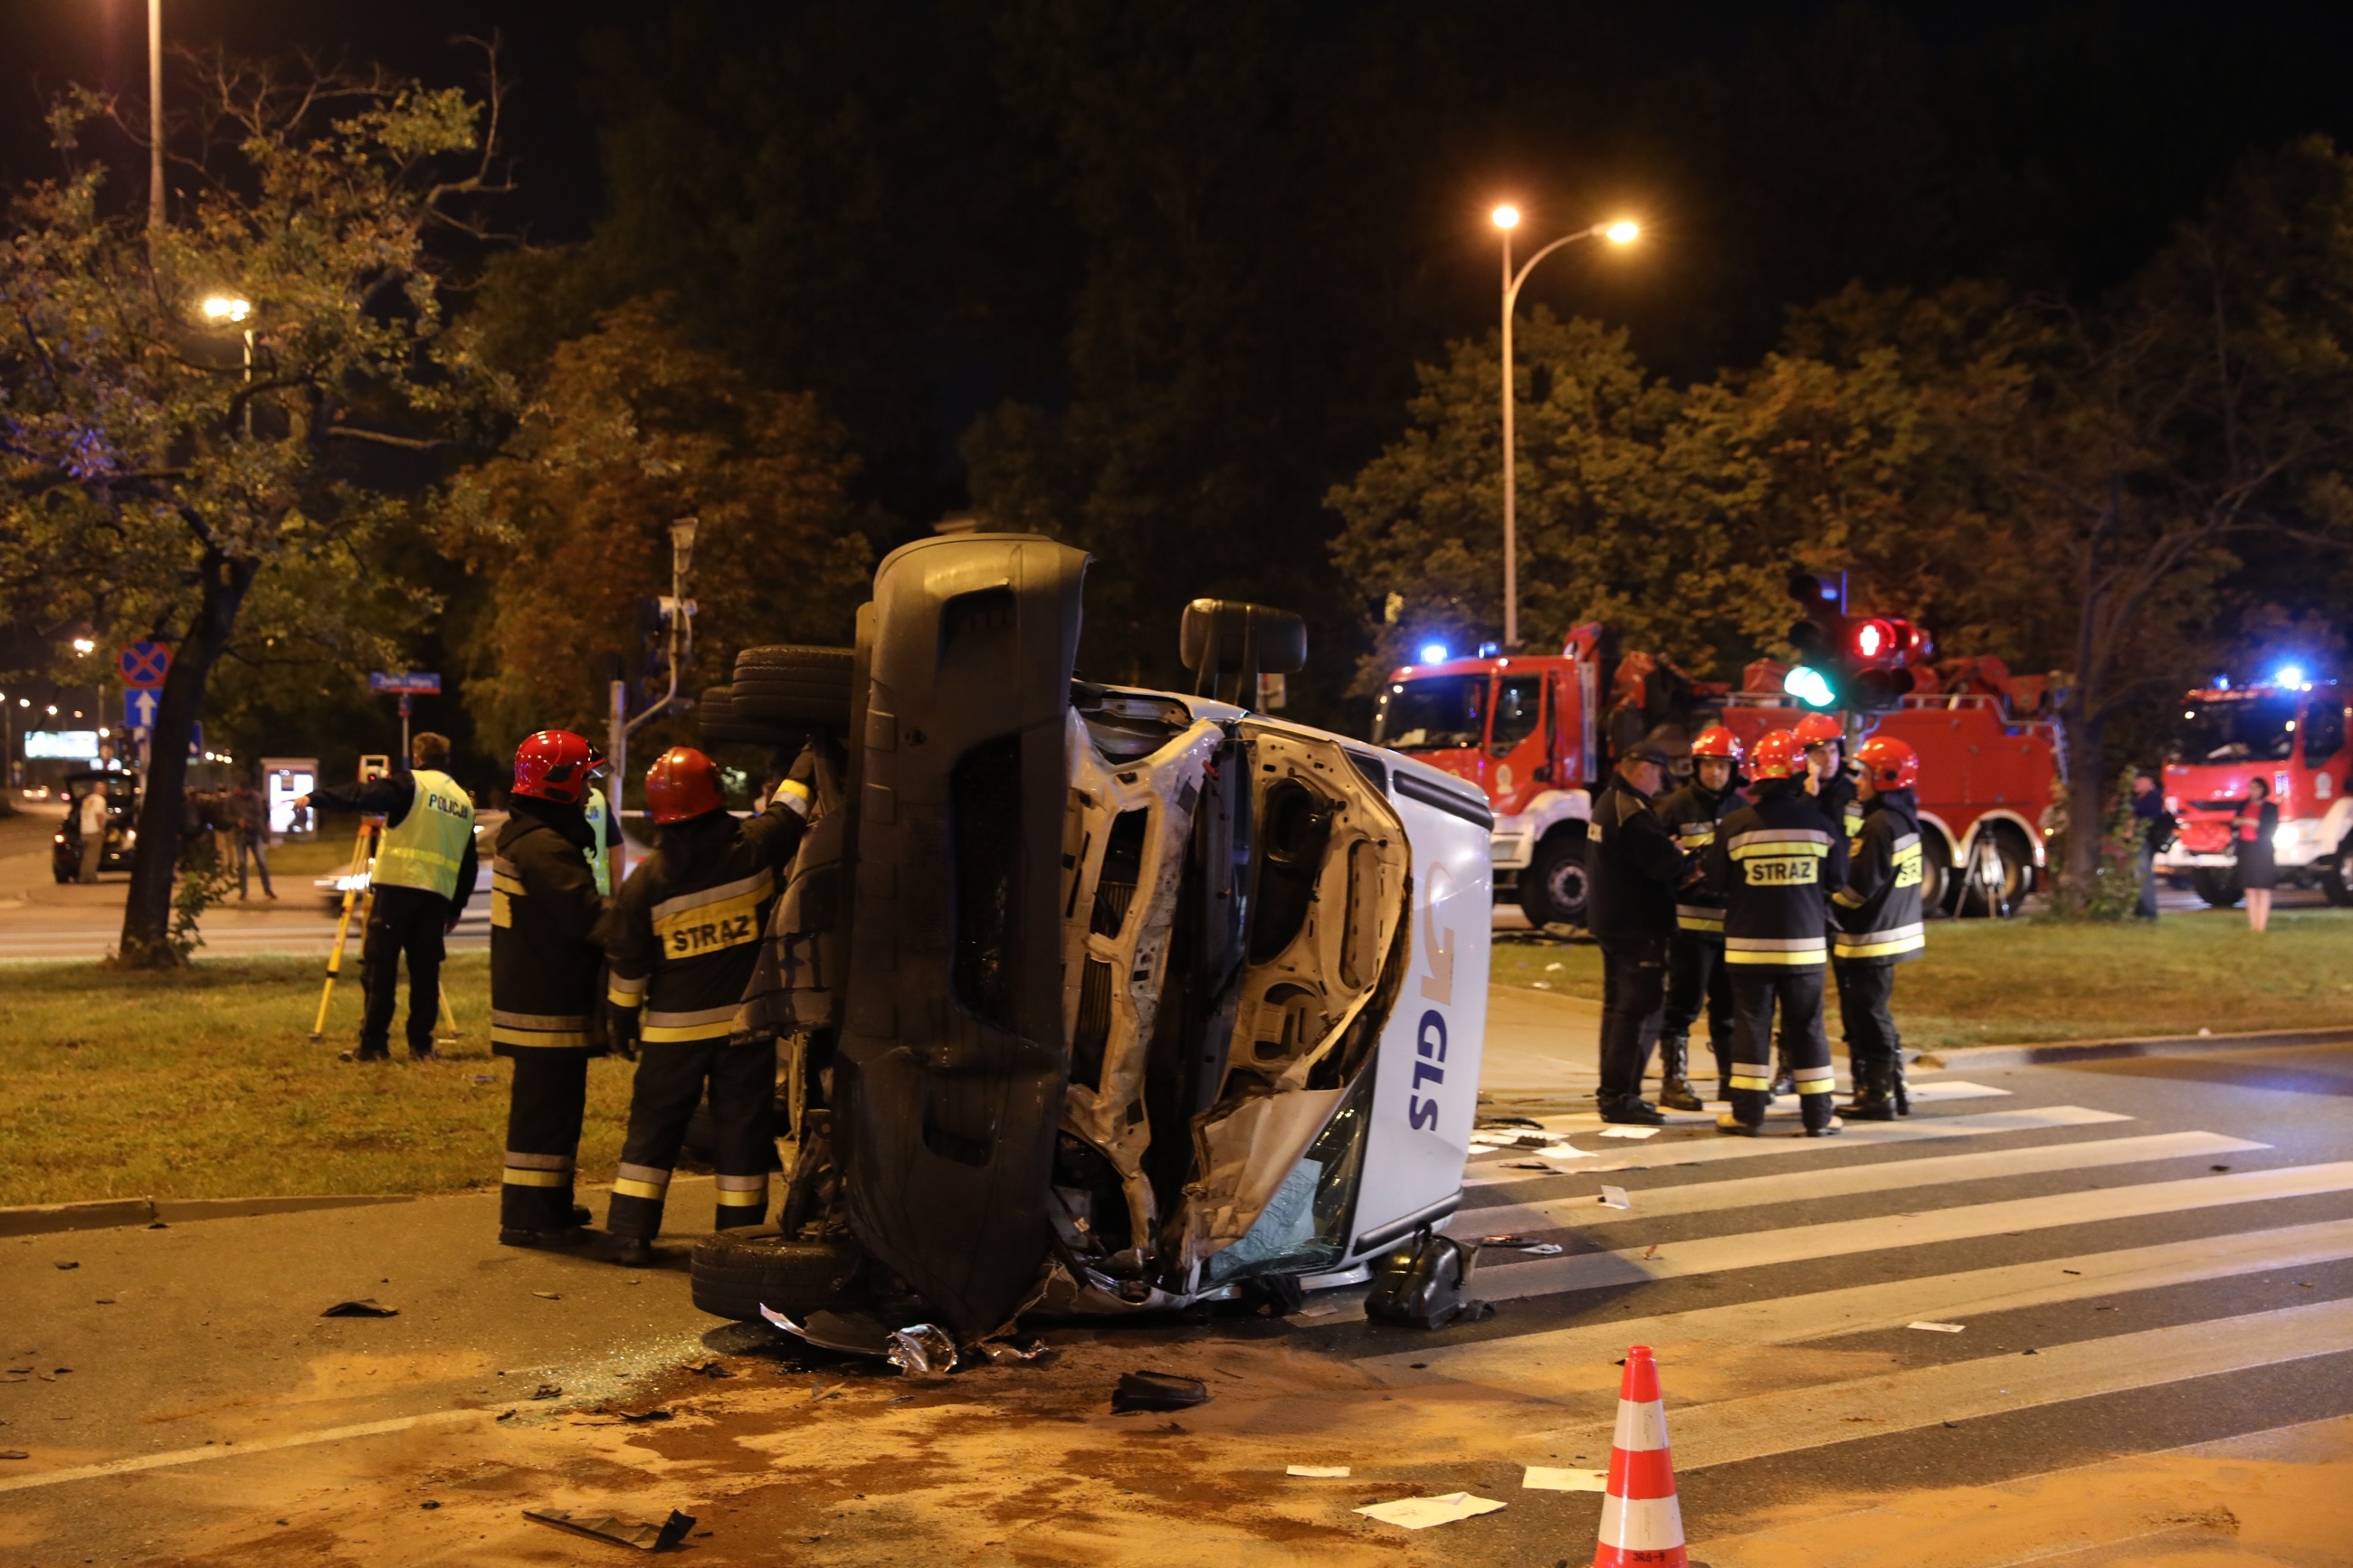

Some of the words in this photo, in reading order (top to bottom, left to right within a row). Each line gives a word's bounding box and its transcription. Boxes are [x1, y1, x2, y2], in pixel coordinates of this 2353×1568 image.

[1752, 861, 1811, 880] STRAZ
[673, 915, 750, 952] STRAZ
[1409, 1009, 1447, 1132] GLS
